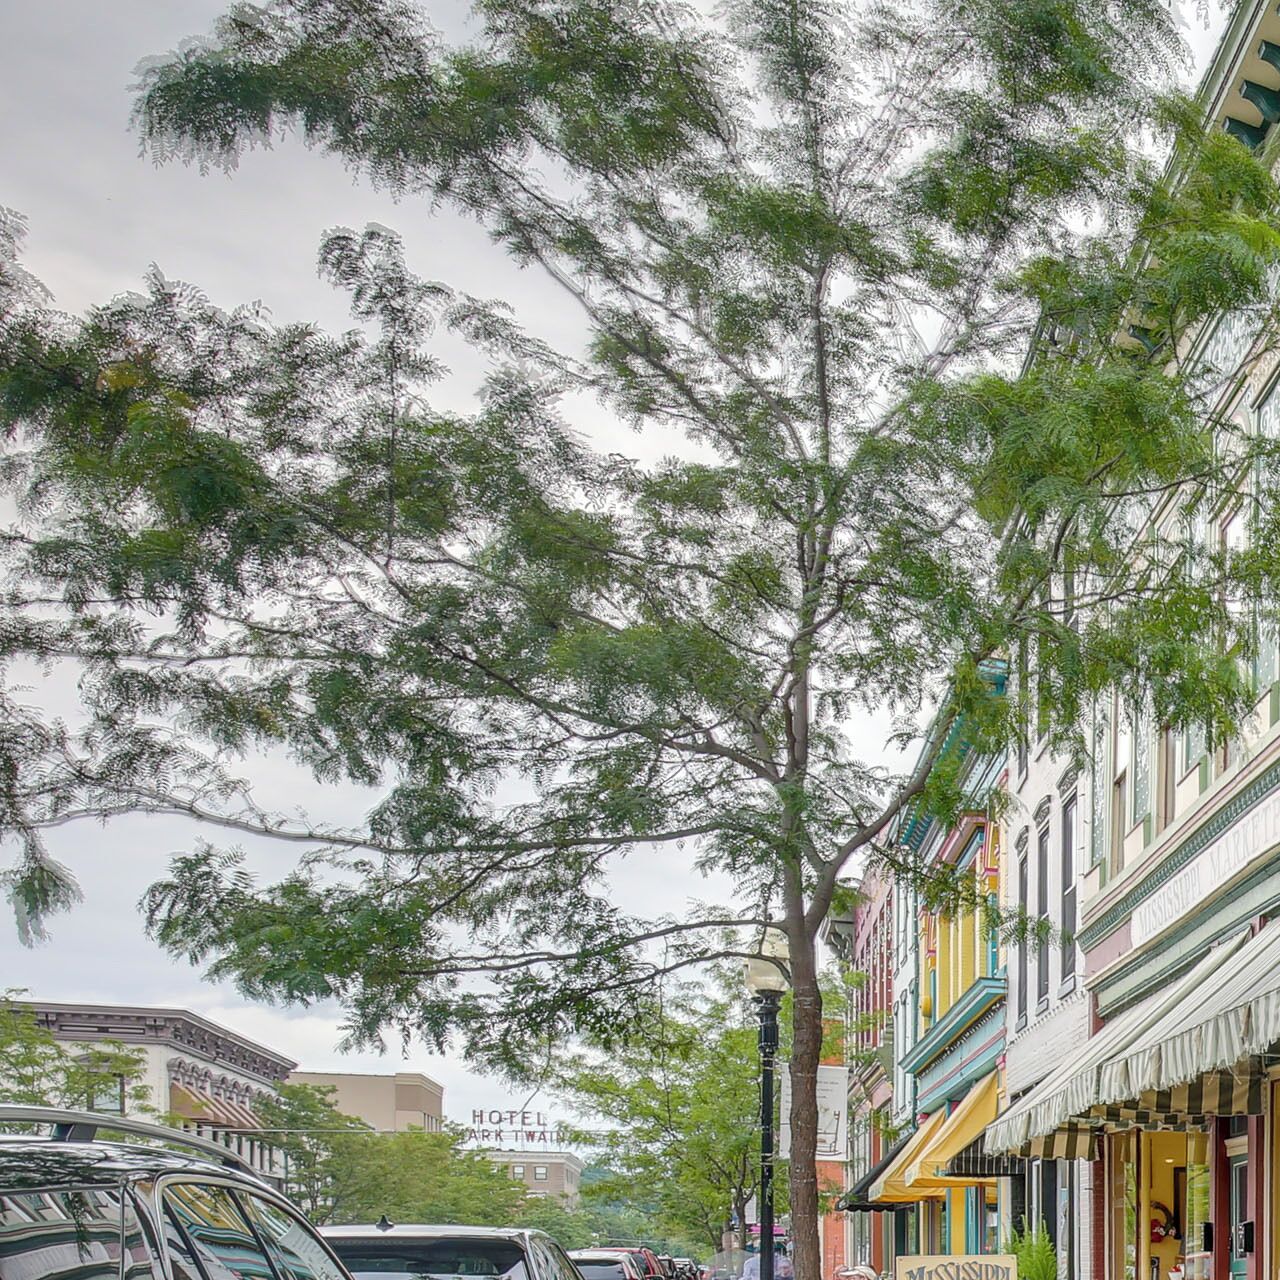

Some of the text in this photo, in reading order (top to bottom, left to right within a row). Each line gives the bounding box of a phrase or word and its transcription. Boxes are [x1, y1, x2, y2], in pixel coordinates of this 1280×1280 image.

[1138, 861, 1202, 940] MISSISSIPPI
[472, 1109, 548, 1127] HOTEL
[466, 1129, 566, 1144] ARK TWAIN
